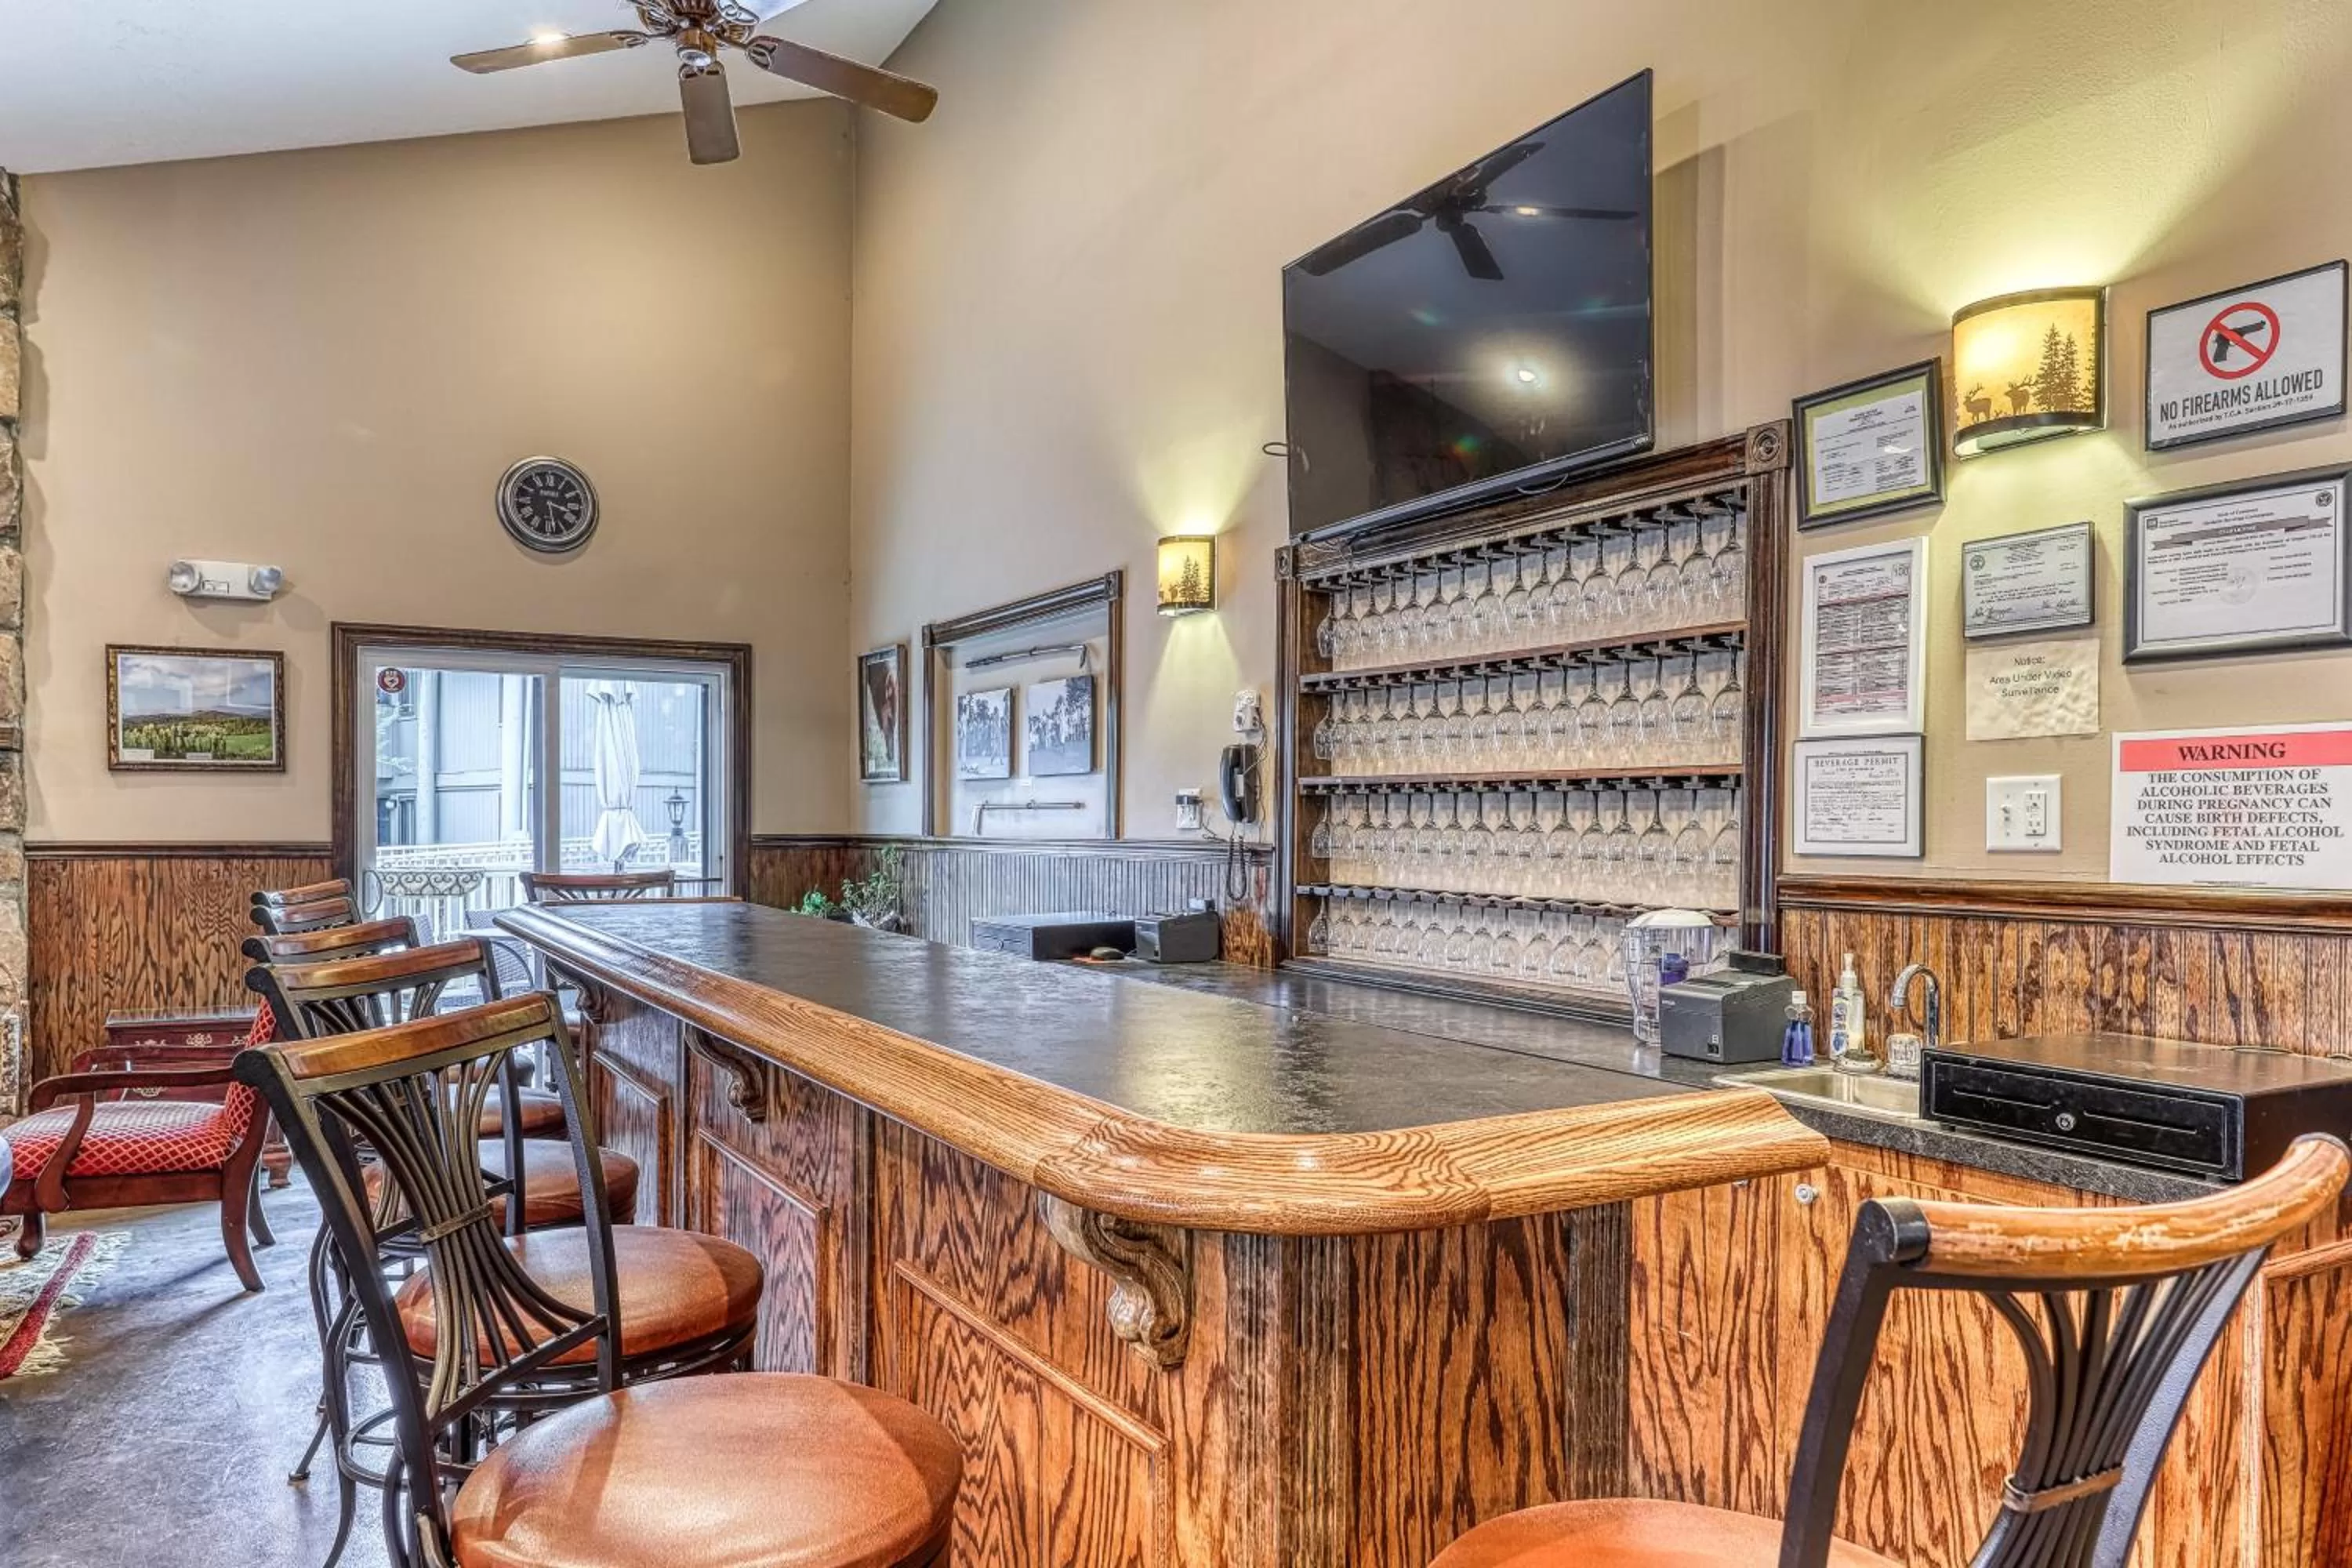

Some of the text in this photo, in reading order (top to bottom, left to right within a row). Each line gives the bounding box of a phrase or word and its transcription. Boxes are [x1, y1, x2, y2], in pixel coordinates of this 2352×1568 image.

[2160, 368, 2322, 423] NO FIREARMS ALLOWED
[2014, 656, 2045, 666] Notice:
[2013, 674, 2042, 683] Under
[2043, 670, 2072, 680] Video
[2001, 686, 2060, 698] Surveillance
[2178, 742, 2287, 761] WARNING
[1864, 757, 1900, 766] PERMIT
[2148, 768, 2321, 783] THE CONSUMPTION OF
[2141, 783, 2328, 797] ALCOHOLIC BEVERAGES
[2137, 797, 2332, 810] DURING PREGNANCY CAN
[2145, 812, 2324, 824] CAUSE BIRTH DEFECTS,
[2127, 826, 2345, 838] INCLUDING FETAL ALCOHOL
[2145, 840, 2321, 852] SYNDROME AND FETAL
[2158, 853, 2305, 866] ALCOHOL EFFECTS
